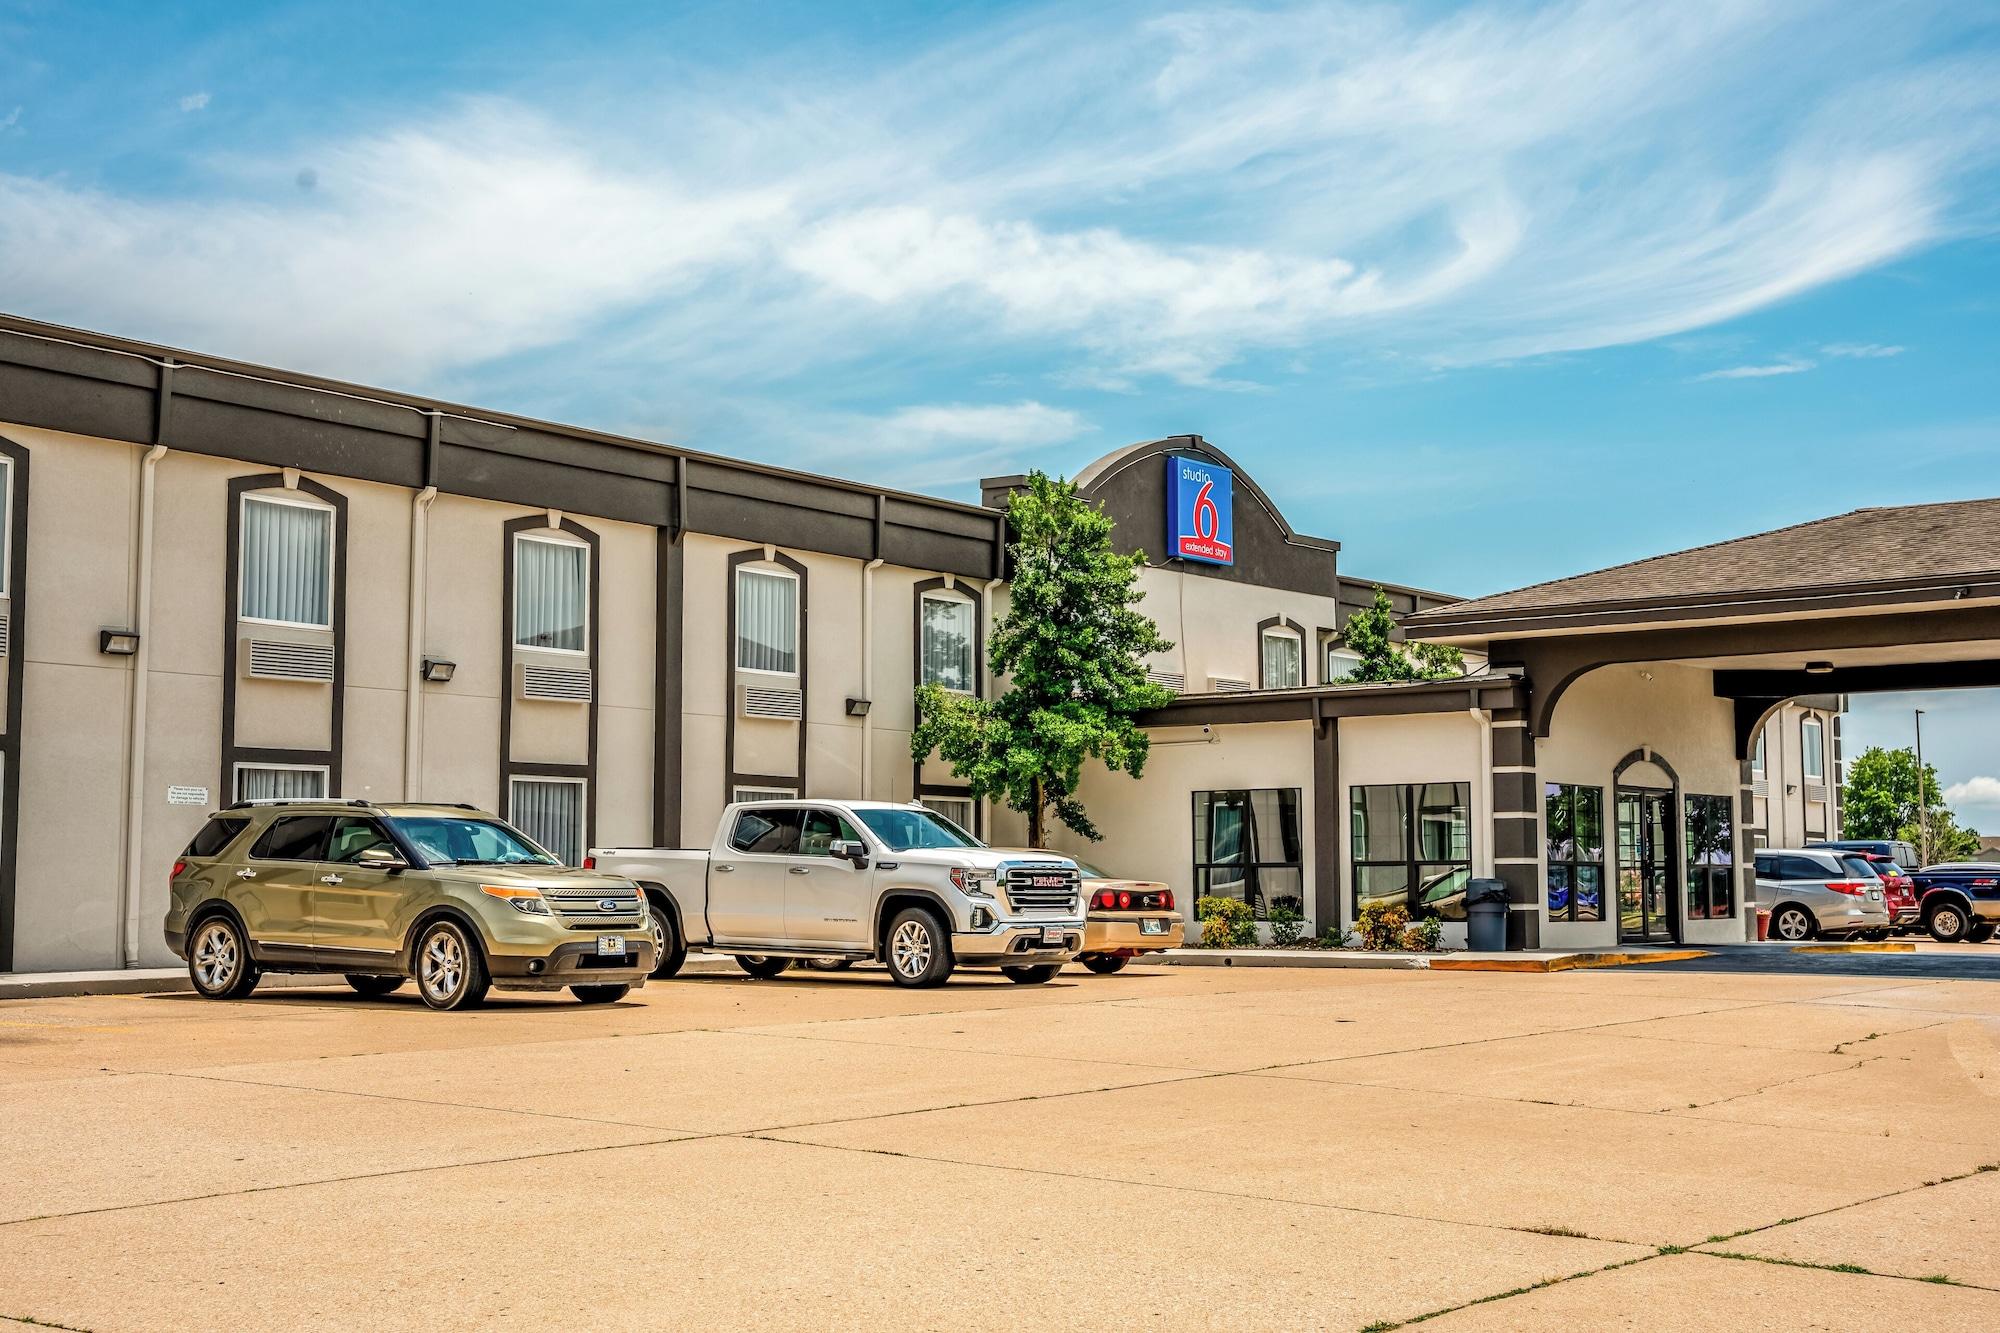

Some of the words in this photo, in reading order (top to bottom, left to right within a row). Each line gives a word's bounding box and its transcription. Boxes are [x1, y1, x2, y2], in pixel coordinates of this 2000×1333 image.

[1182, 468, 1210, 482] studio
[1193, 480, 1219, 542] 6
[1185, 542, 1213, 555] extended
[1214, 548, 1228, 560] stay
[1033, 876, 1064, 887] GMC
